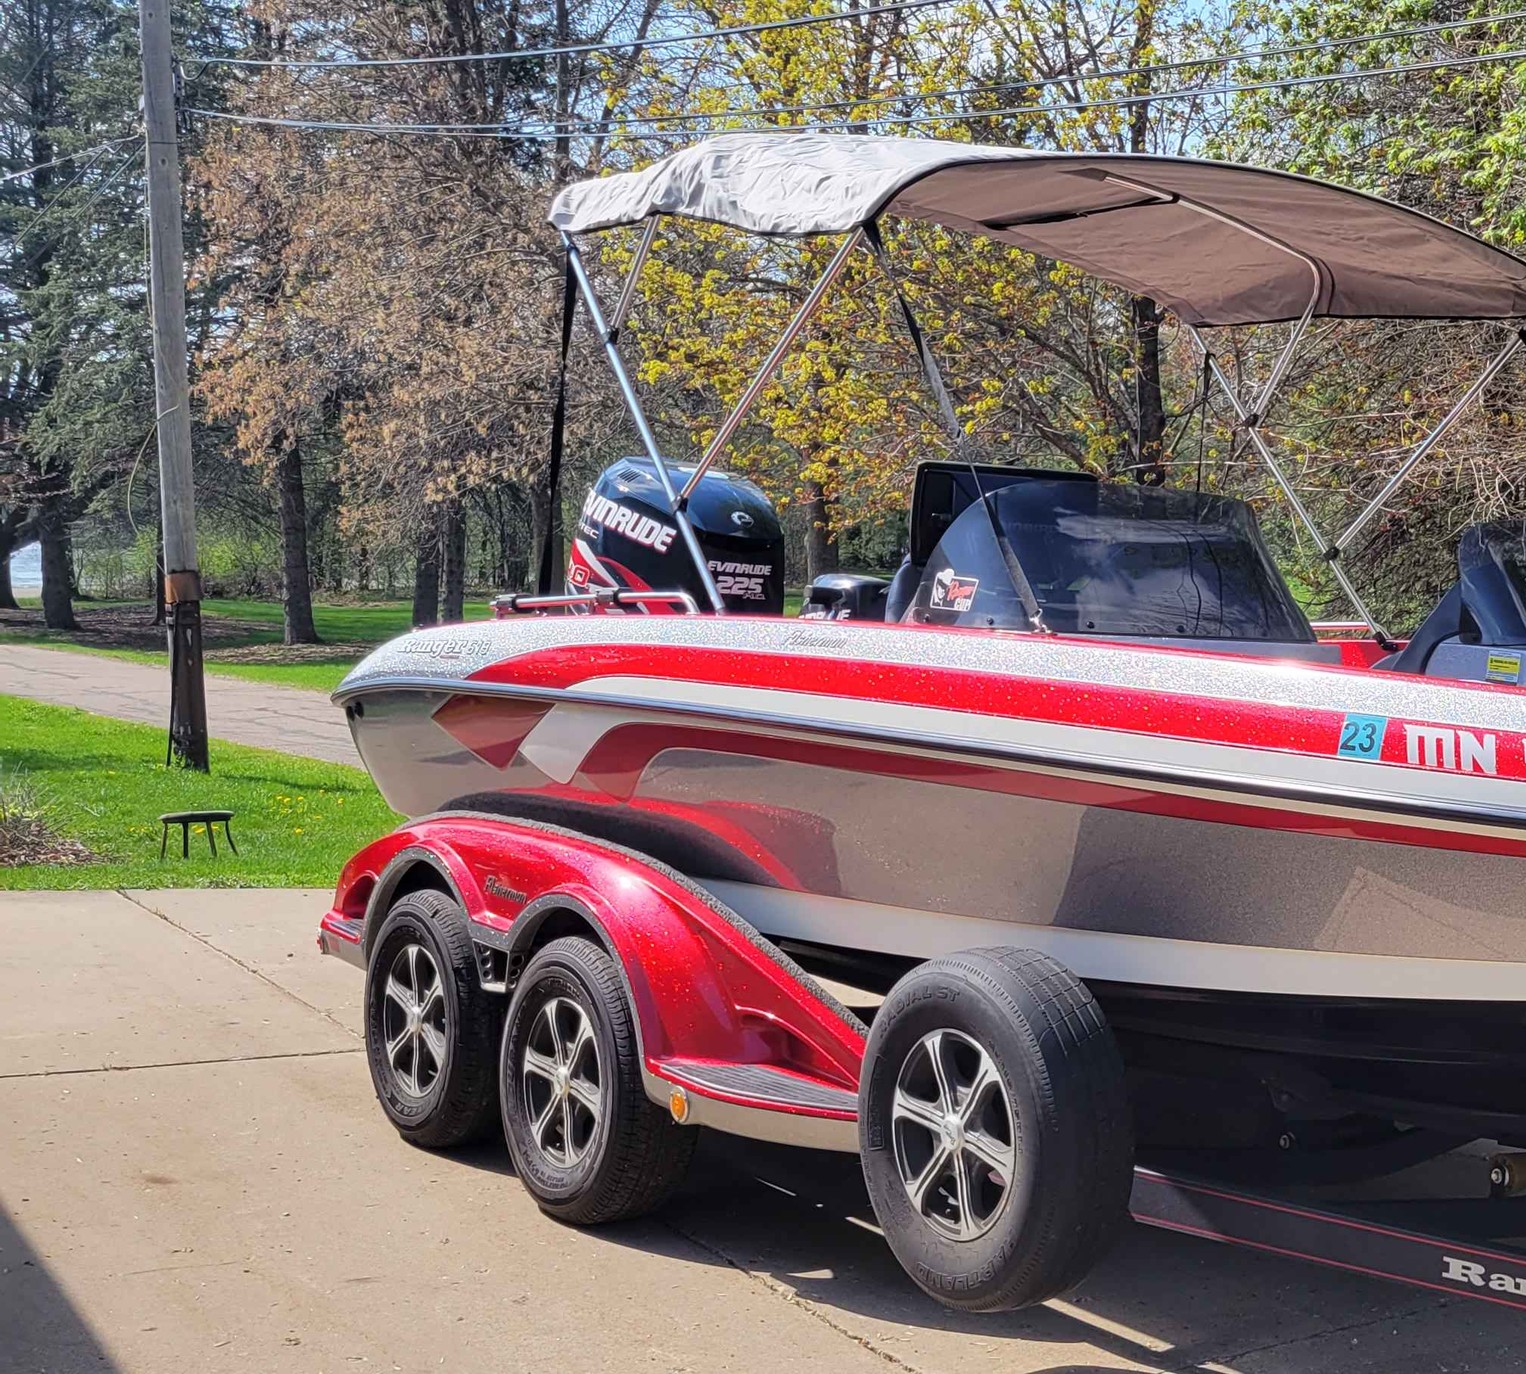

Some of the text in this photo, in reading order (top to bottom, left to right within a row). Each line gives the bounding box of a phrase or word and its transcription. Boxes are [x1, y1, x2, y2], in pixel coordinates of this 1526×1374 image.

[707, 560, 773, 576] EVINRUDE
[716, 575, 764, 595] 225
[397, 638, 469, 659] Ranger
[1340, 722, 1377, 753] 23
[1404, 724, 1497, 774] MN
